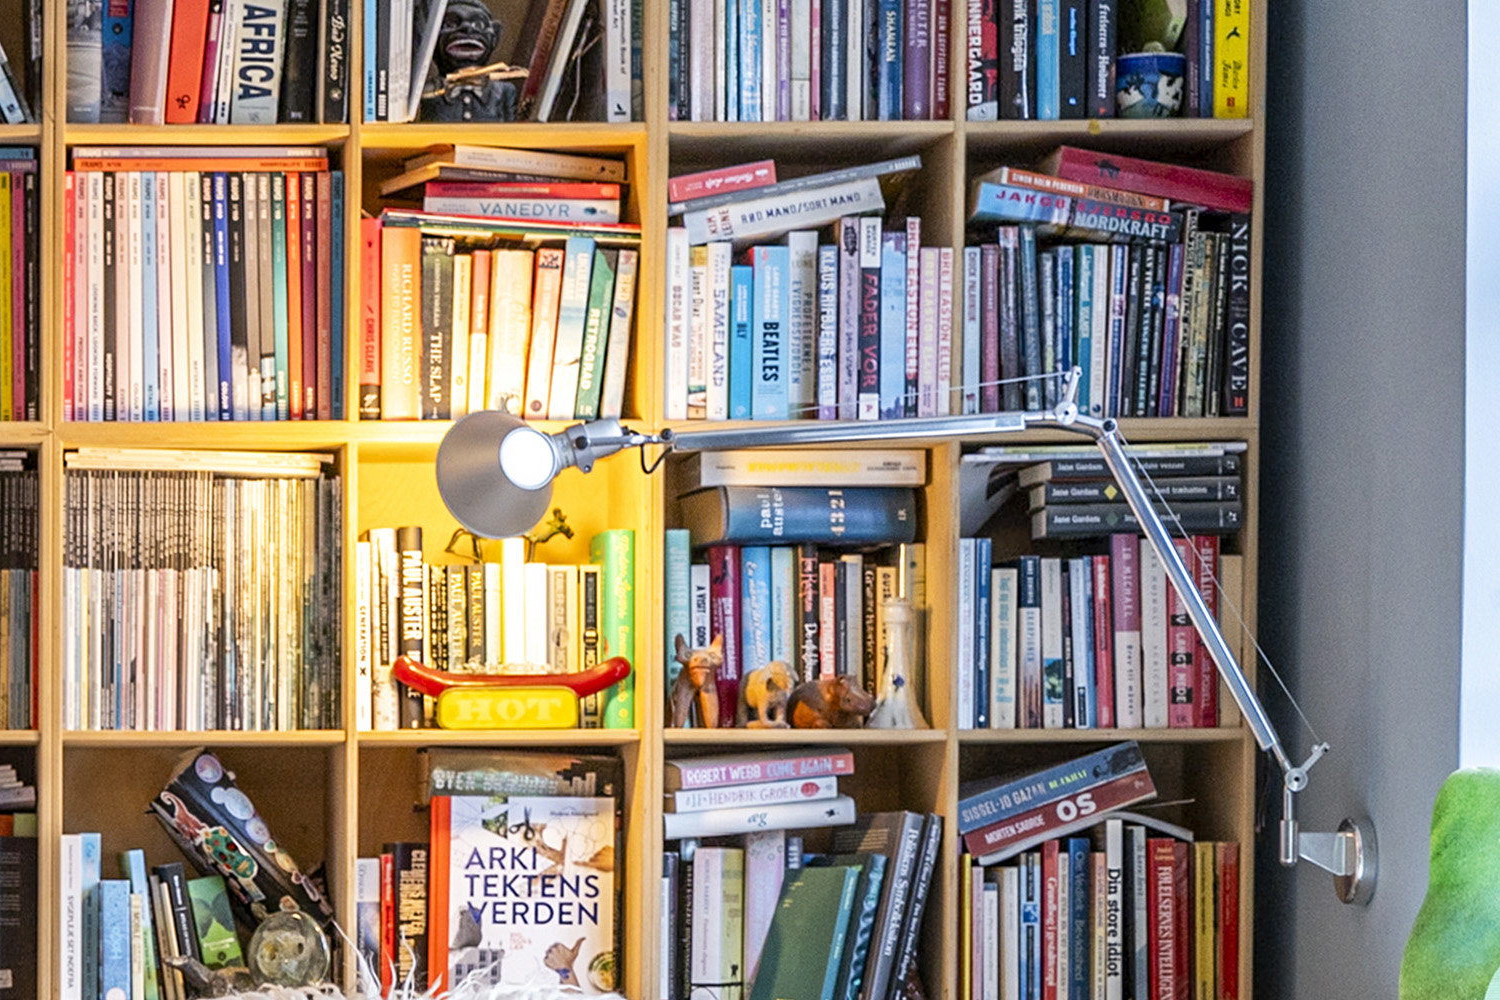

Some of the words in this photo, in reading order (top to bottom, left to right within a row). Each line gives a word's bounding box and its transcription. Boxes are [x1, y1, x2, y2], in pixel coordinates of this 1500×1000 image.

[329, 15, 345, 42] Bad
[238, 4, 278, 101] AFRICA
[479, 202, 570, 217] VANEDYR
[830, 192, 861, 206] MAND
[996, 189, 1067, 210] JAKOB
[1077, 202, 1173, 226] EJERSBO
[906, 220, 918, 256] BRET
[1077, 211, 1170, 240] NORDKRAFT
[820, 250, 836, 290] KLAUS
[967, 252, 978, 277] CHUCK
[1231, 223, 1248, 291] NICK
[402, 263, 413, 334] RICHARD
[863, 273, 878, 337] FADER
[906, 264, 918, 332] EASTON
[939, 289, 951, 342] EASTON
[365, 318, 375, 343] CHRIS
[712, 288, 726, 387] SAMELAND
[736, 323, 747, 339] BLY
[820, 293, 836, 355] RIFBJERG
[365, 345, 375, 374] CLEAVE
[402, 336, 413, 385] RUSSO
[430, 332, 443, 365] THE
[580, 308, 601, 390] RETROGRAD
[762, 322, 779, 382] BEATLES
[863, 345, 877, 387] VOR
[939, 345, 951, 382] ELLIS
[1231, 322, 1248, 390] CAVE
[430, 366, 443, 403] SLAP
[828, 490, 847, 536] 4321
[402, 550, 422, 585] PAUL
[1122, 547, 1132, 561] IB
[450, 572, 466, 605] PAUL
[470, 571, 483, 601] PAUL
[671, 547, 687, 604] JENNIFER
[1122, 565, 1133, 619] MICHAEL
[402, 587, 422, 641] AUSTER
[697, 593, 706, 613] VISIT
[450, 607, 465, 660] AUSTER
[470, 602, 483, 648] AUSTER
[1176, 632, 1187, 669] LANGT
[1176, 673, 1187, 703] NEDE
[455, 699, 562, 722] HOT
[686, 767, 728, 786] ROBERT
[729, 763, 762, 782] WEBB
[1055, 792, 1098, 822] OS
[464, 846, 538, 870] ARKI
[464, 874, 600, 898] TEKTENS
[1107, 868, 1122, 895] Din
[466, 901, 599, 925] VERDEN
[1107, 900, 1121, 937] store
[1157, 866, 1174, 938] FØLELSERNES
[1107, 943, 1122, 978] idiot
